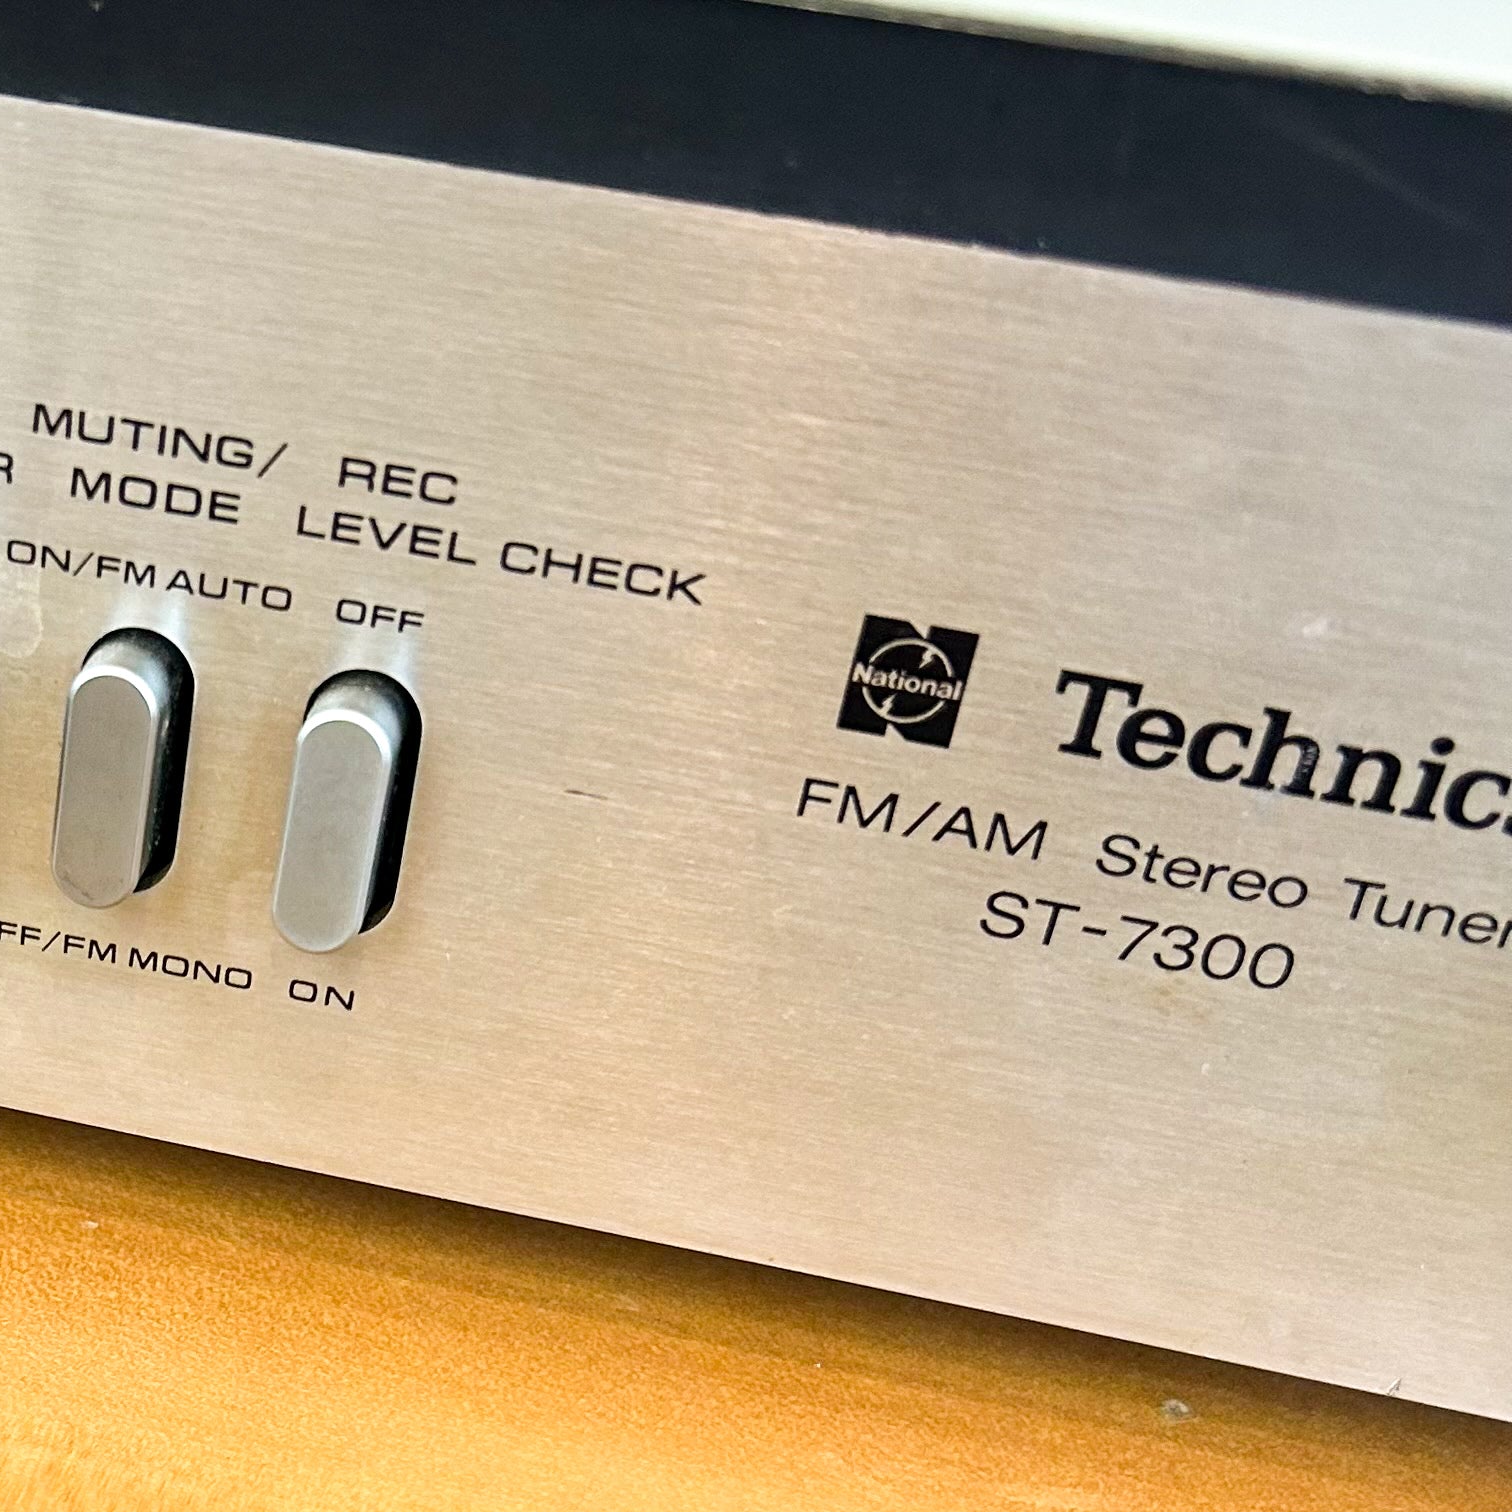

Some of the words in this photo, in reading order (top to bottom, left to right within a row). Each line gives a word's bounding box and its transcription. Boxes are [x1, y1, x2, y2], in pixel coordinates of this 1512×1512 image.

[31, 401, 290, 481] MUTING/
[69, 465, 242, 526] MODE
[336, 455, 460, 507] REC
[5, 537, 158, 590] ON/FM
[164, 568, 294, 613] AUTO
[295, 503, 478, 568] LEVEL
[498, 539, 708, 607] CHECK
[334, 597, 427, 636] OFF
[851, 661, 964, 701] National
[1054, 666, 1512, 840] Technic
[795, 776, 1050, 863] FM/AM
[1094, 832, 1310, 910] Stereo
[1342, 876, 1512, 950] Tuner
[127, 945, 254, 992] MONO
[978, 888, 1297, 991] ST-7300
[287, 976, 356, 1013] ON
